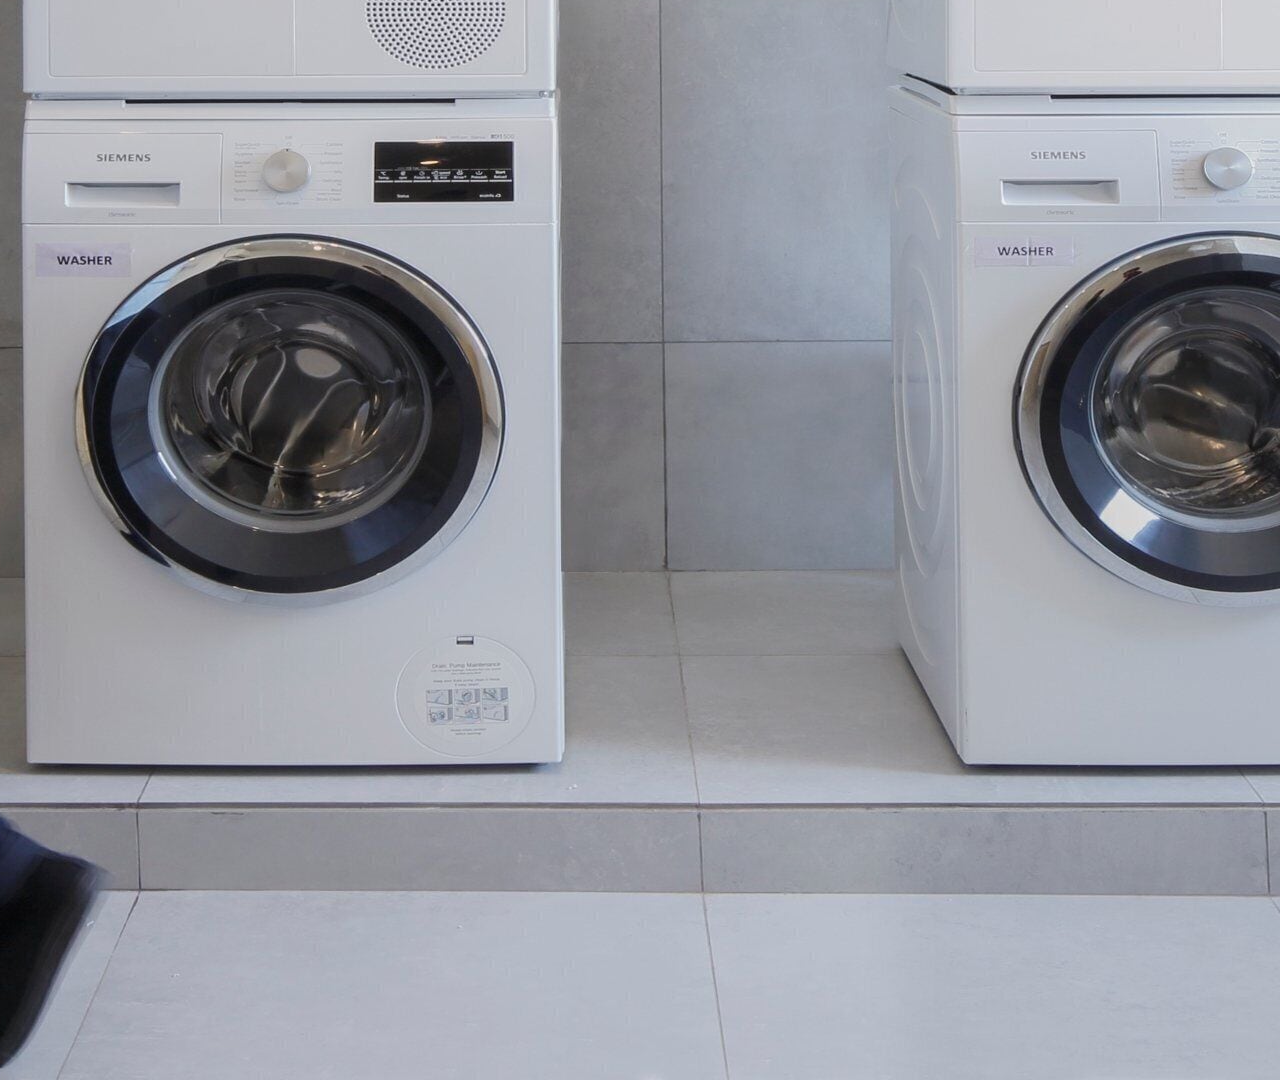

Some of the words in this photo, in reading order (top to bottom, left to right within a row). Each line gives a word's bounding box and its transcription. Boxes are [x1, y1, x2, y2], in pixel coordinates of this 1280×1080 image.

[96, 153, 151, 162] SIEMENS
[1030, 151, 1086, 160] SIEMENS
[997, 246, 1055, 257] WASHER
[56, 255, 112, 266] WASHER
